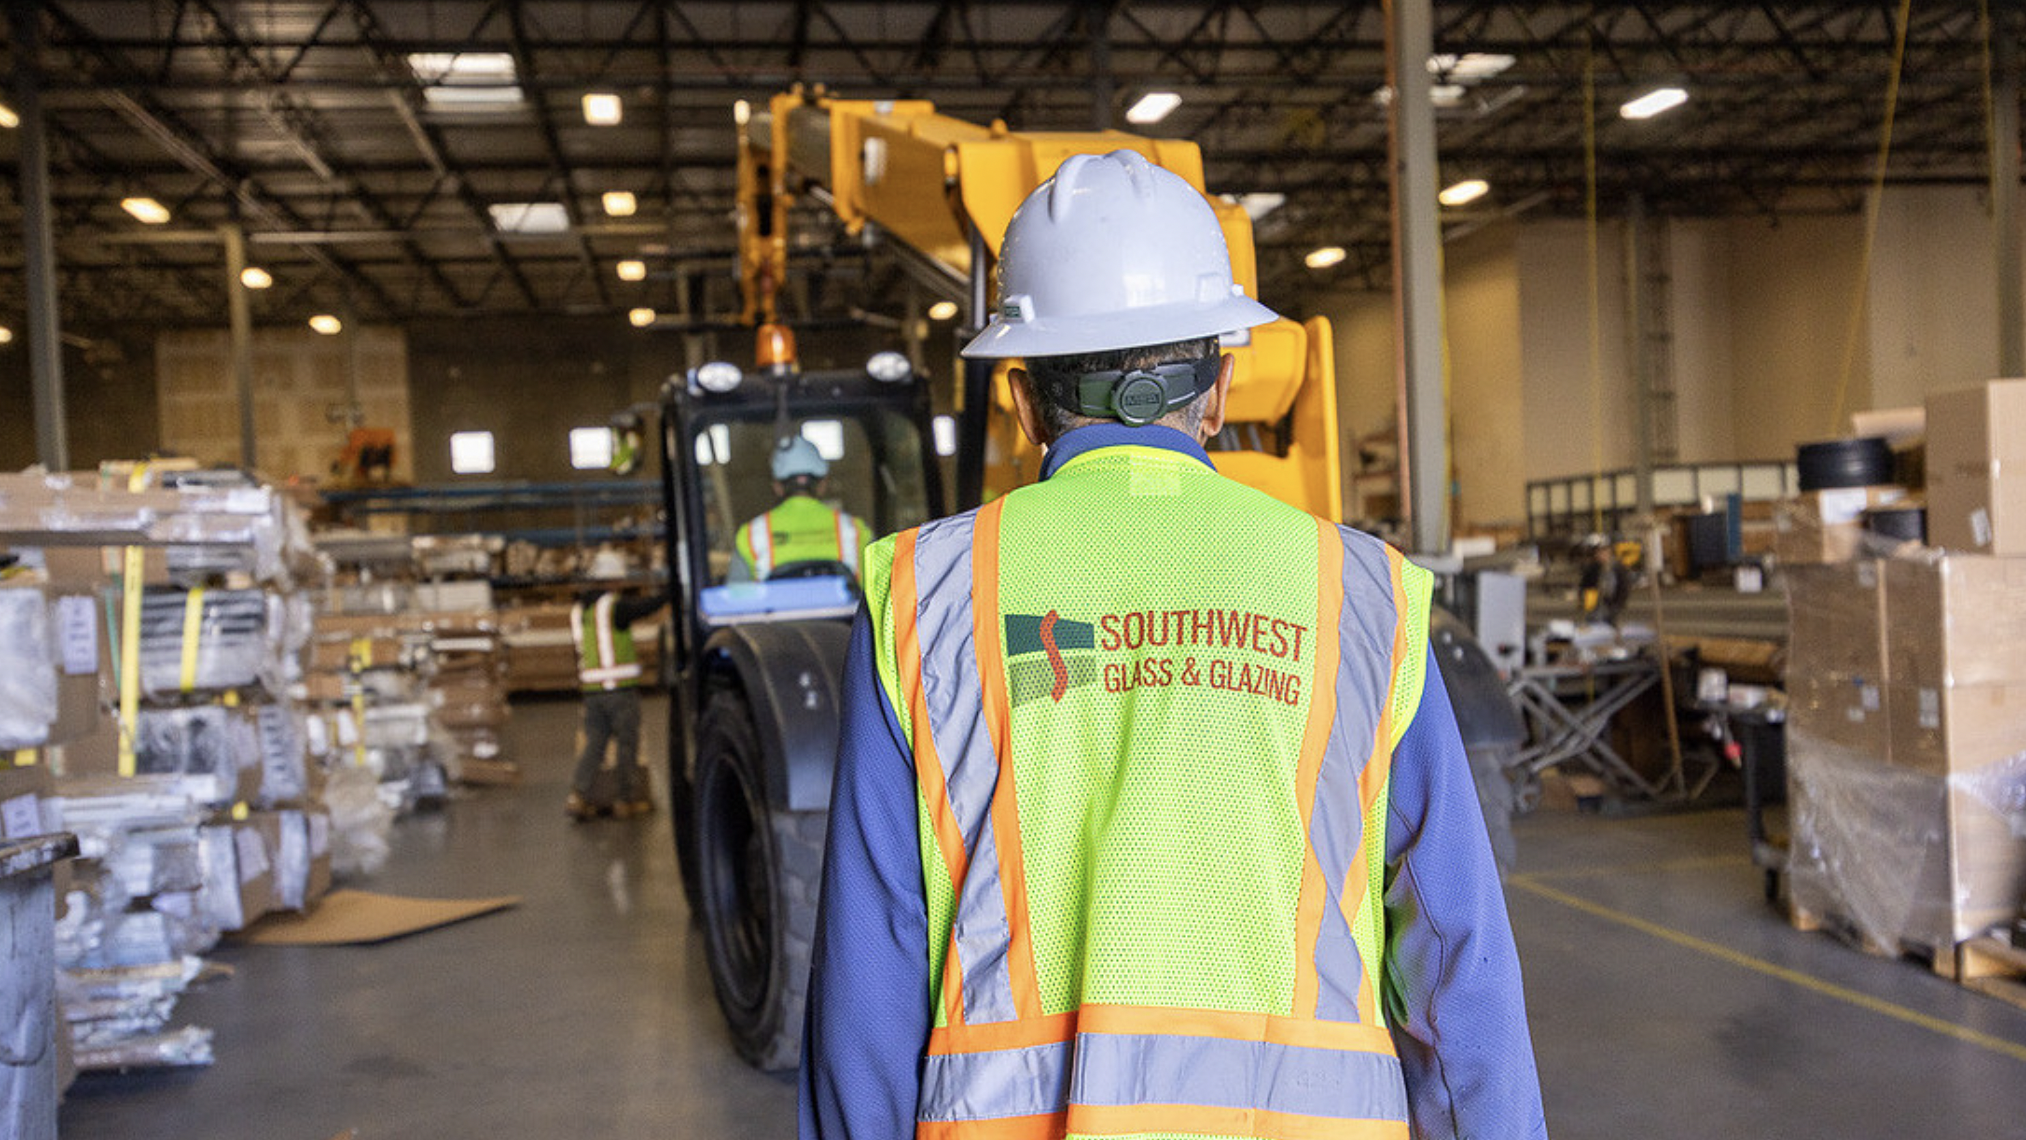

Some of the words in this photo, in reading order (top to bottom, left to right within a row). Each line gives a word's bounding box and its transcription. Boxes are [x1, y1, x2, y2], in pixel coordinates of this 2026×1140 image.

[1100, 608, 1308, 662] SOUTHWEST
[1103, 657, 1173, 693] GLASS
[1181, 657, 1201, 686] &
[1208, 659, 1301, 706] GLAZING
